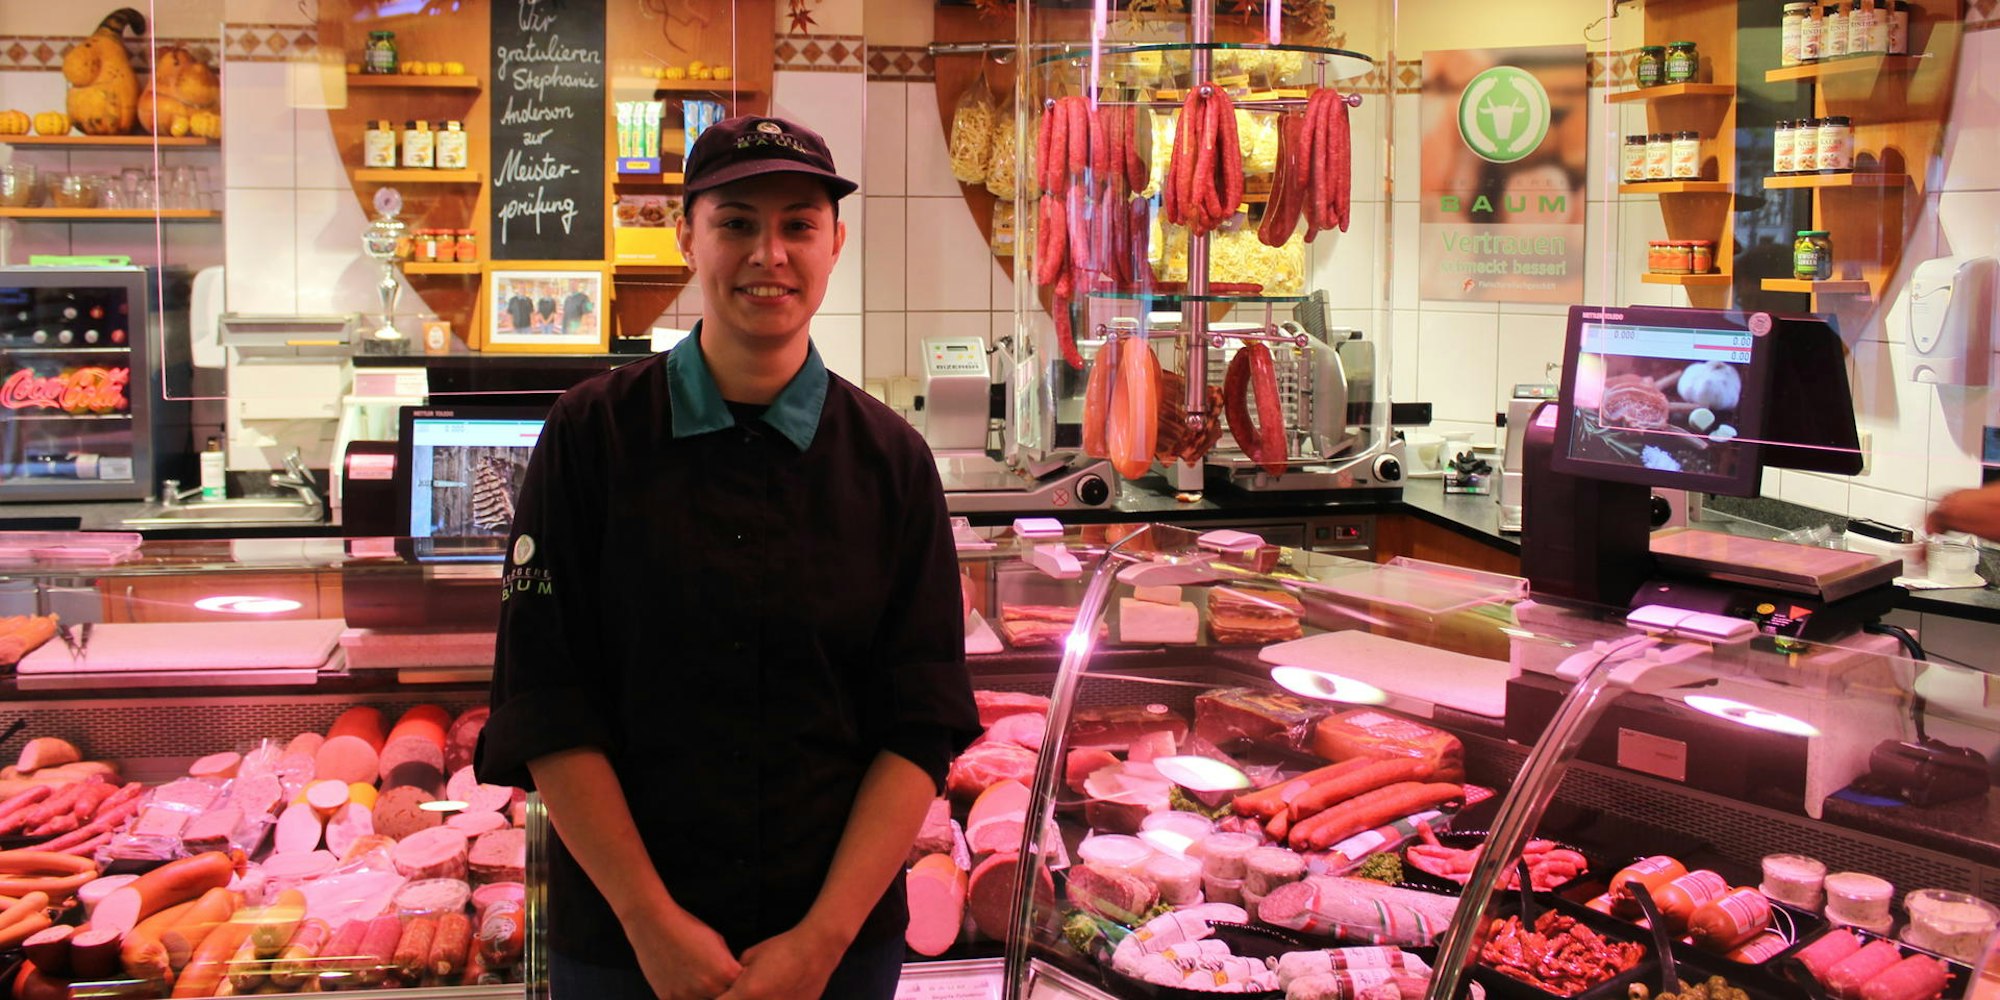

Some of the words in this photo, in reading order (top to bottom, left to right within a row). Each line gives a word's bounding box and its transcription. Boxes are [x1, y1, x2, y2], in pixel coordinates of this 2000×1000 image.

[519, 0, 557, 32] Wir
[497, 34, 601, 81] gratulieren
[512, 65, 599, 102] Stephanie
[500, 95, 574, 125] Anderson
[523, 128, 554, 146] zur
[494, 148, 580, 187] Meister-
[498, 186, 579, 245] prüfung
[1440, 195, 1566, 213] BAUM
[1441, 230, 1566, 255] Vertrauen
[1614, 330, 1636, 340] 0.000
[1732, 336, 1751, 347] 0.00
[1731, 351, 1750, 362] 0.00
